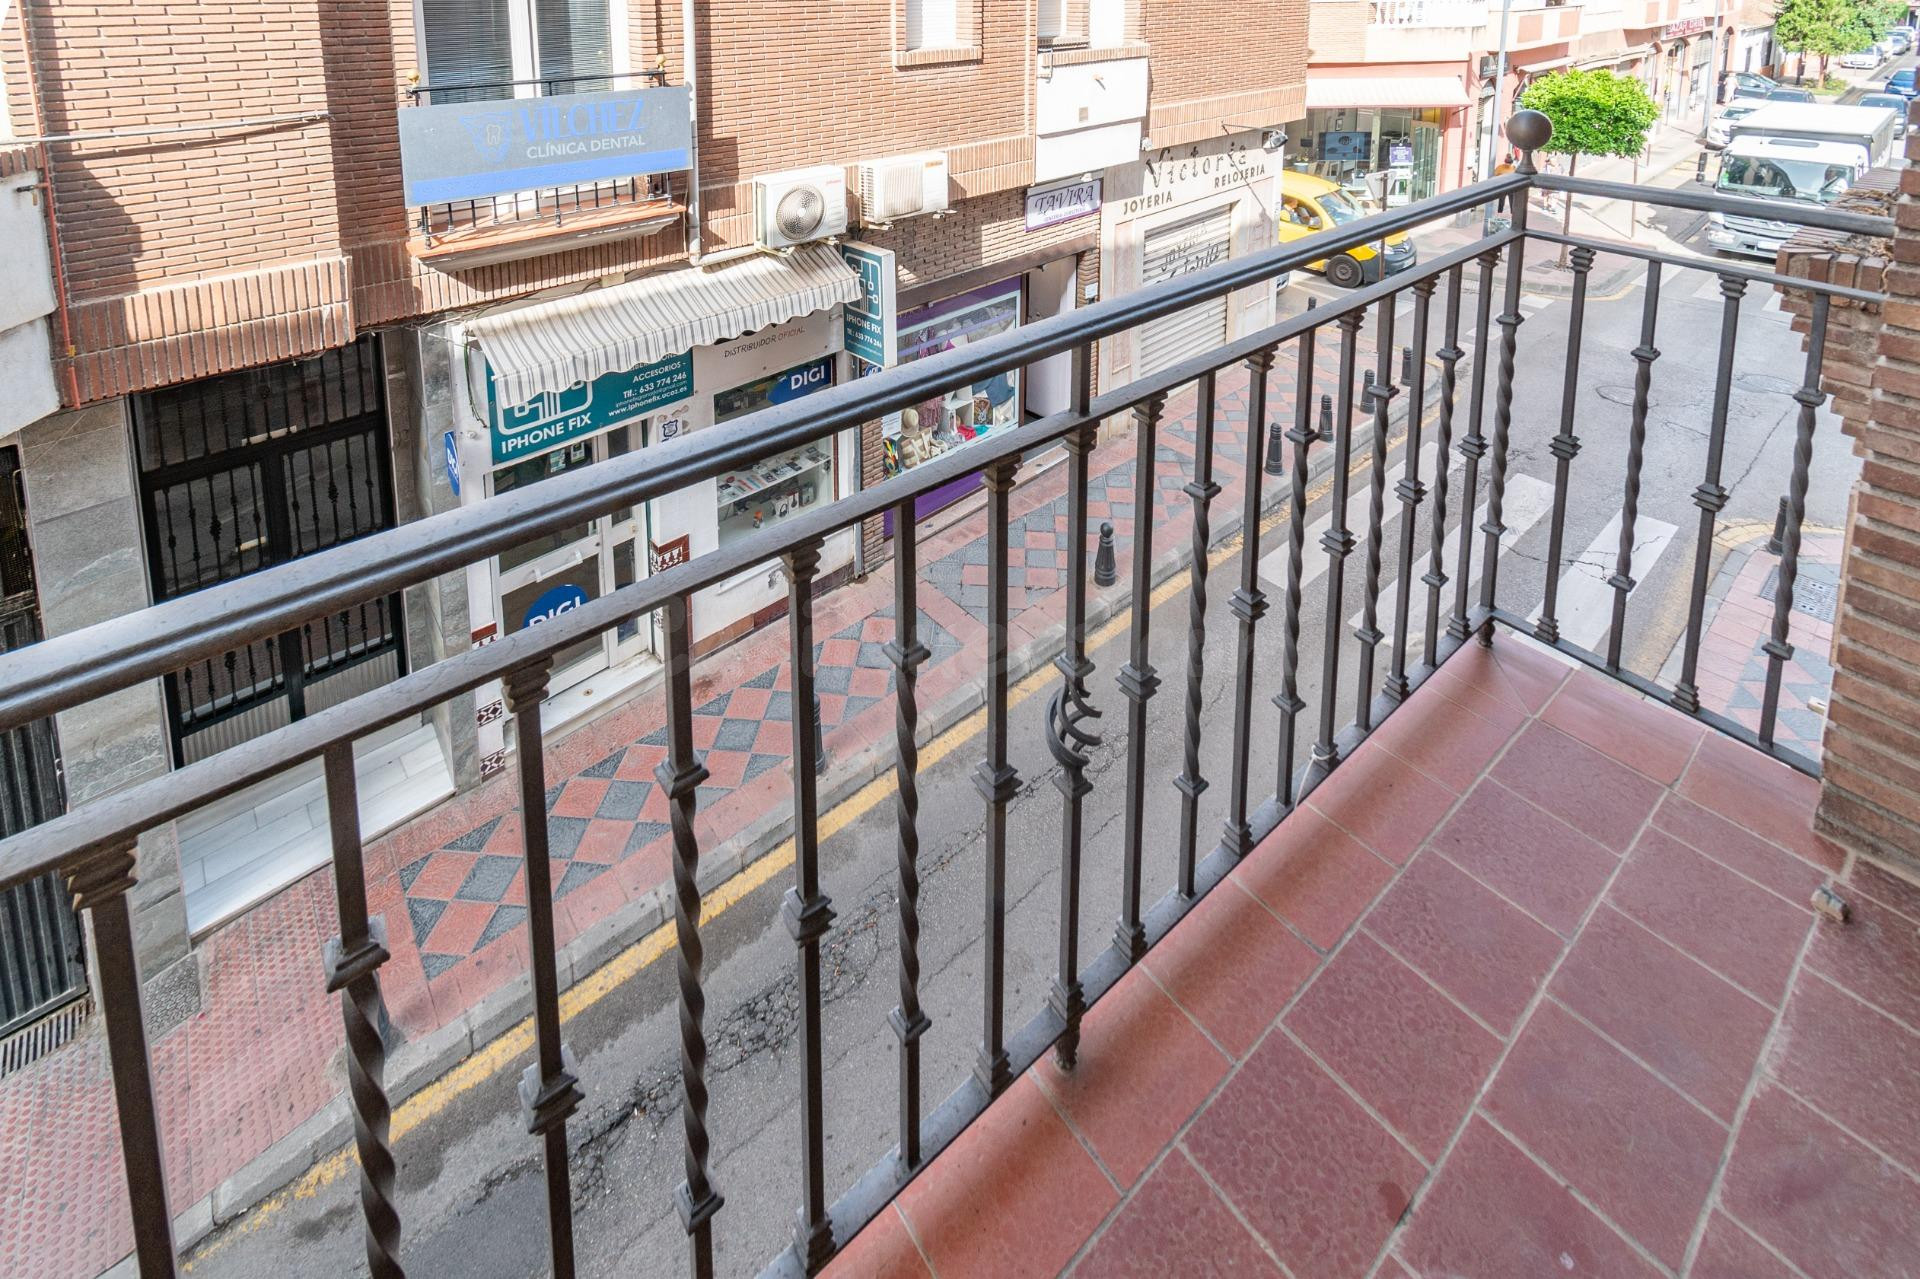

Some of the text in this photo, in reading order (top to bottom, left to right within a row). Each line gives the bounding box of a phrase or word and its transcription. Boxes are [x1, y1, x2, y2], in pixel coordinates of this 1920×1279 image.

[526, 135, 646, 159] CLÍNICA DENTAL
[1034, 184, 1094, 214] TAVIRA
[1123, 190, 1173, 215] JOYERIA
[846, 313, 882, 335] IPHONE FIX
[724, 326, 806, 358] DISTRIBUIDOR OFICIAL
[632, 361, 681, 383] ACCESORIOS
[639, 383, 655, 394] 633
[656, 377, 671, 388] 774
[672, 371, 687, 382] 246
[791, 365, 825, 390] DIGI
[501, 412, 592, 454] IPHONE FIX
